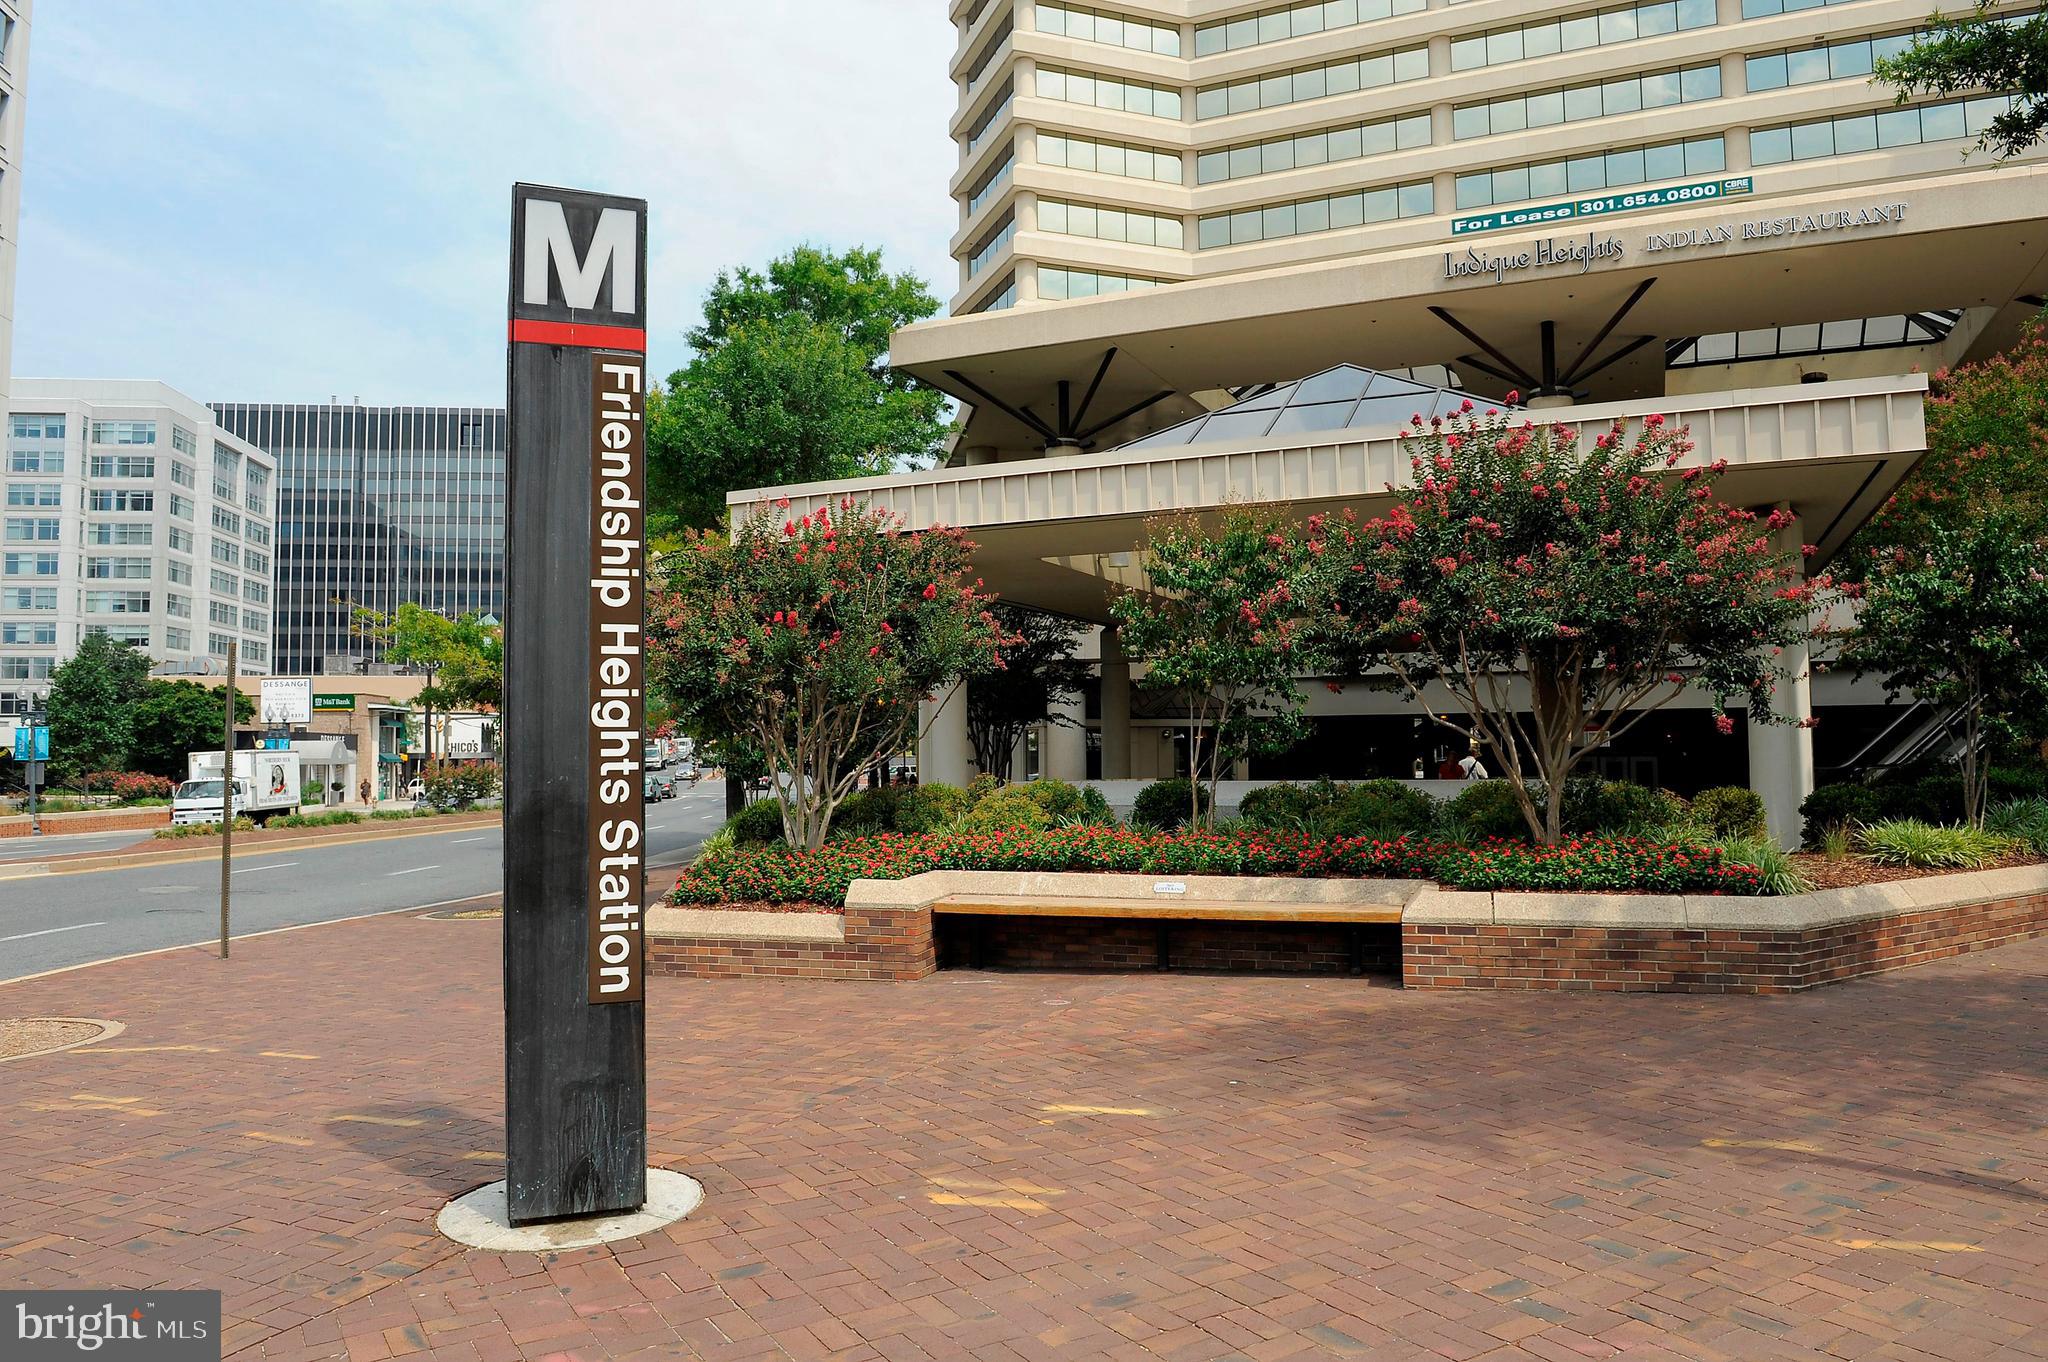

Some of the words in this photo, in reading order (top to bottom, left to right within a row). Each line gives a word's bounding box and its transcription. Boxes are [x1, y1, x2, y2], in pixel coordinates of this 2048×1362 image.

[1453, 218, 1493, 232] For
[1500, 204, 1571, 225] Lease
[1580, 184, 1717, 213] 301.654.0800
[1724, 178, 1749, 188] CBRE
[523, 198, 637, 314] M
[1443, 246, 1530, 284] Indique
[1533, 231, 1625, 274] Heights
[1645, 223, 1735, 252] INDIAN
[1742, 202, 1908, 240] RESTAURANT
[590, 363, 641, 608] Friendship
[322, 698, 335, 706] M&T
[335, 698, 351, 706] Bank
[590, 623, 640, 805] Heights
[598, 819, 640, 993] Station
